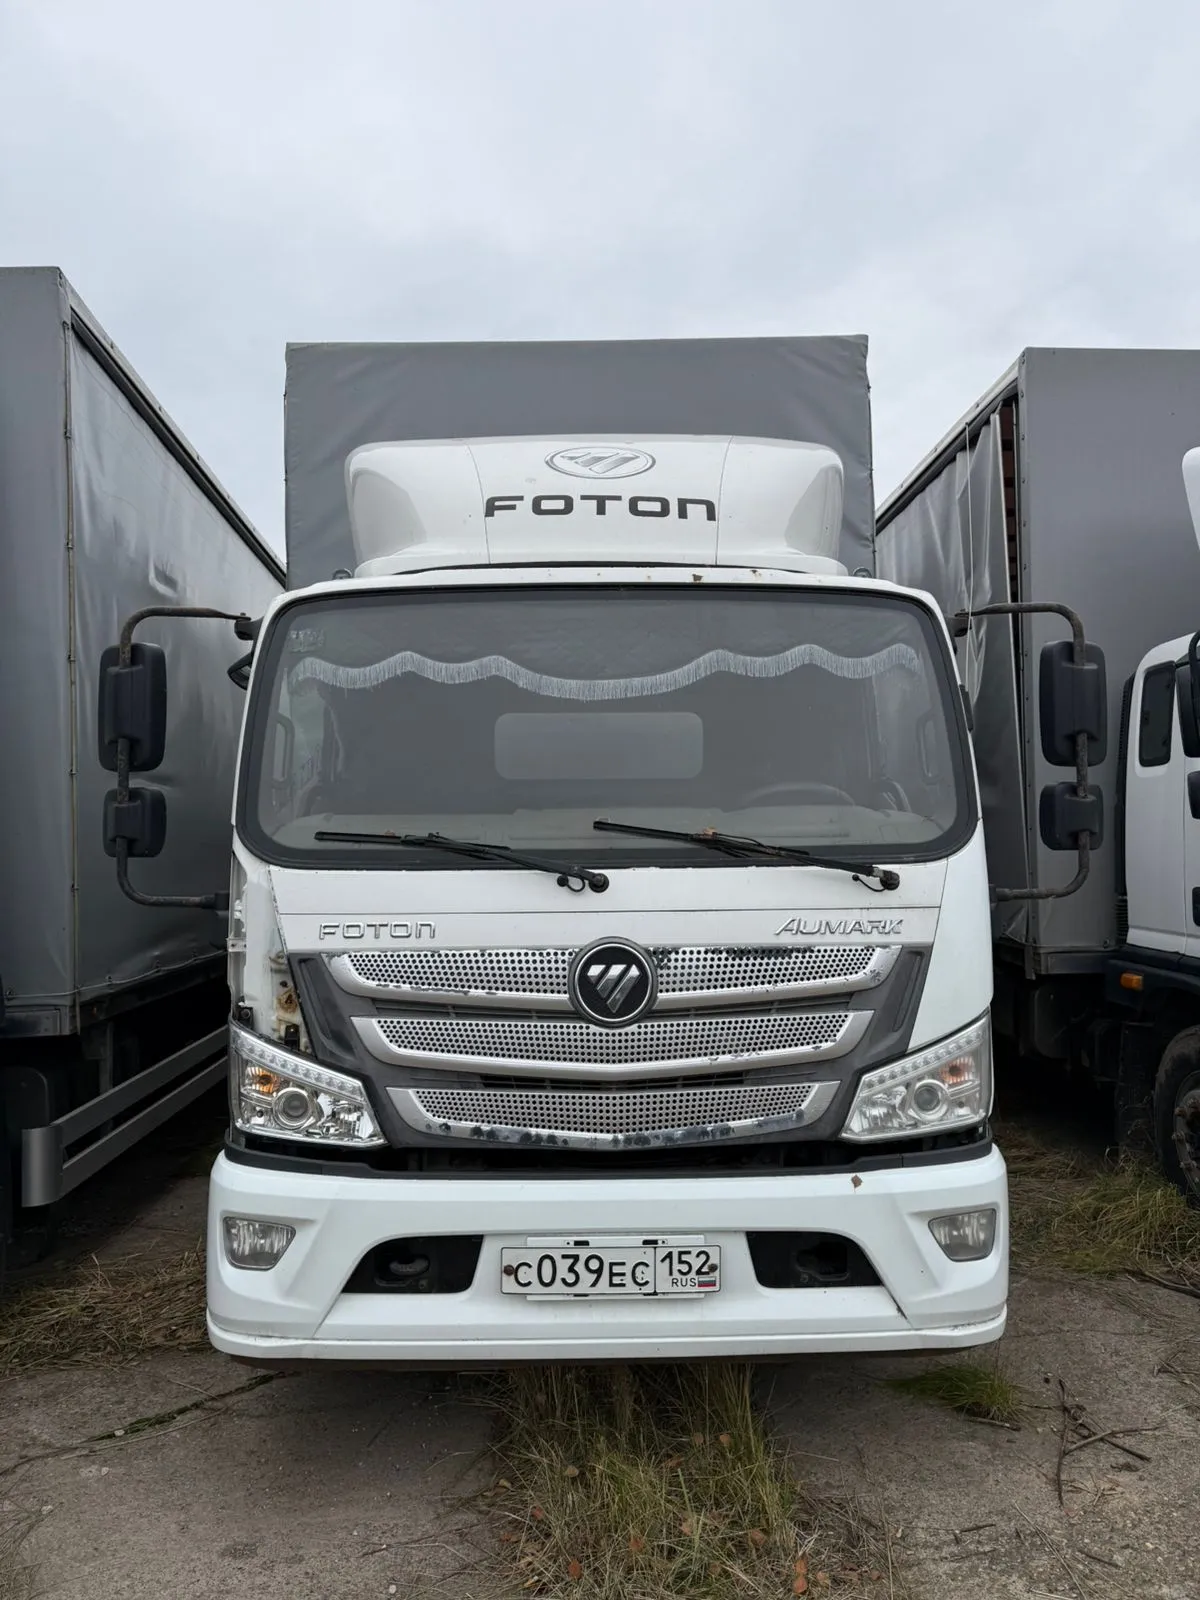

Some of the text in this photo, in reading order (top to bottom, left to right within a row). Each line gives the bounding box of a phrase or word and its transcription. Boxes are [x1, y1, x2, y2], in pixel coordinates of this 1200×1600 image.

[485, 494, 716, 521] FOTON
[319, 921, 436, 940] FOTON
[774, 917, 904, 936] AUMARK
[659, 1249, 711, 1277] 152
[671, 1277, 697, 1288] RUS
